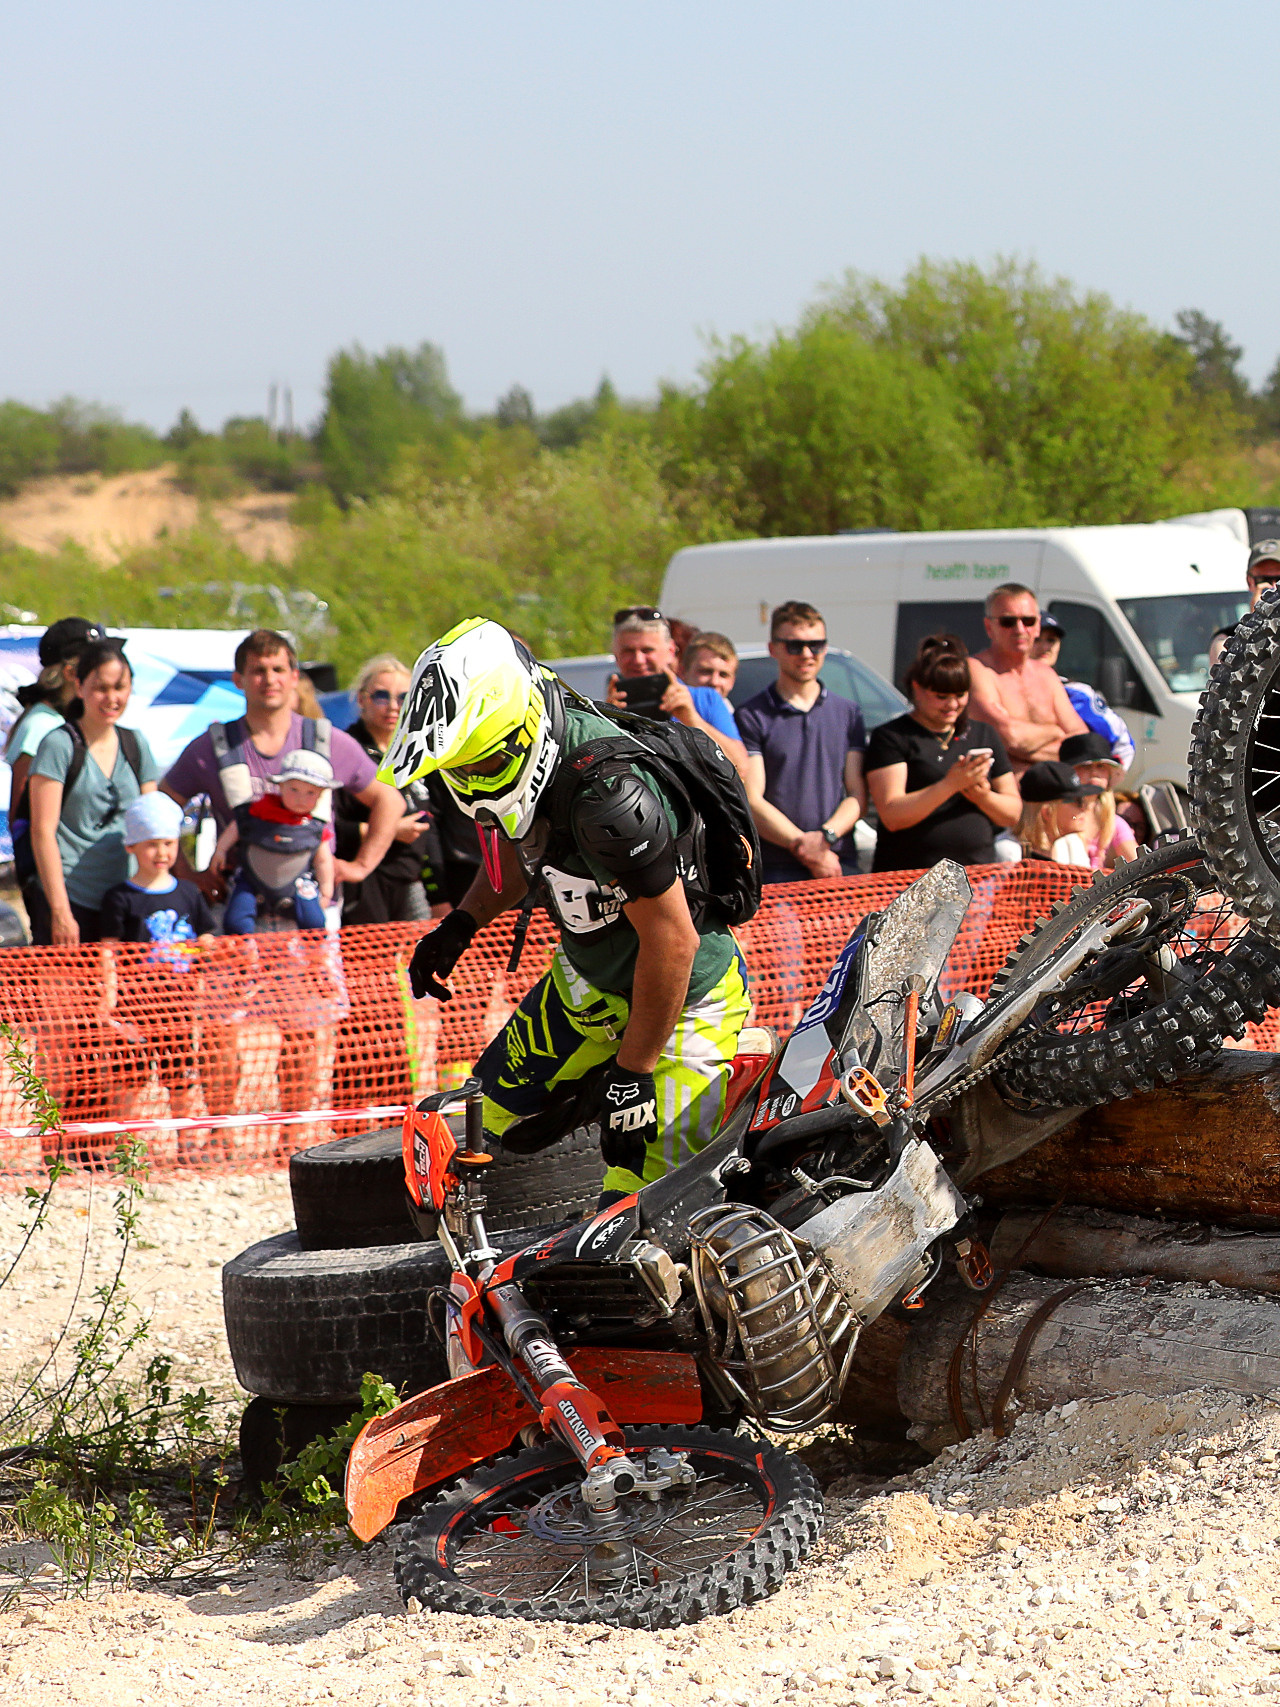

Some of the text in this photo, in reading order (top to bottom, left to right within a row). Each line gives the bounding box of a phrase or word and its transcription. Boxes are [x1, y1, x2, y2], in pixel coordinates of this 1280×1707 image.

[925, 564, 1010, 580] health team
[609, 1099, 657, 1133] FOX
[527, 1339, 575, 1379] WP
[557, 1400, 597, 1450] DUNLOP
